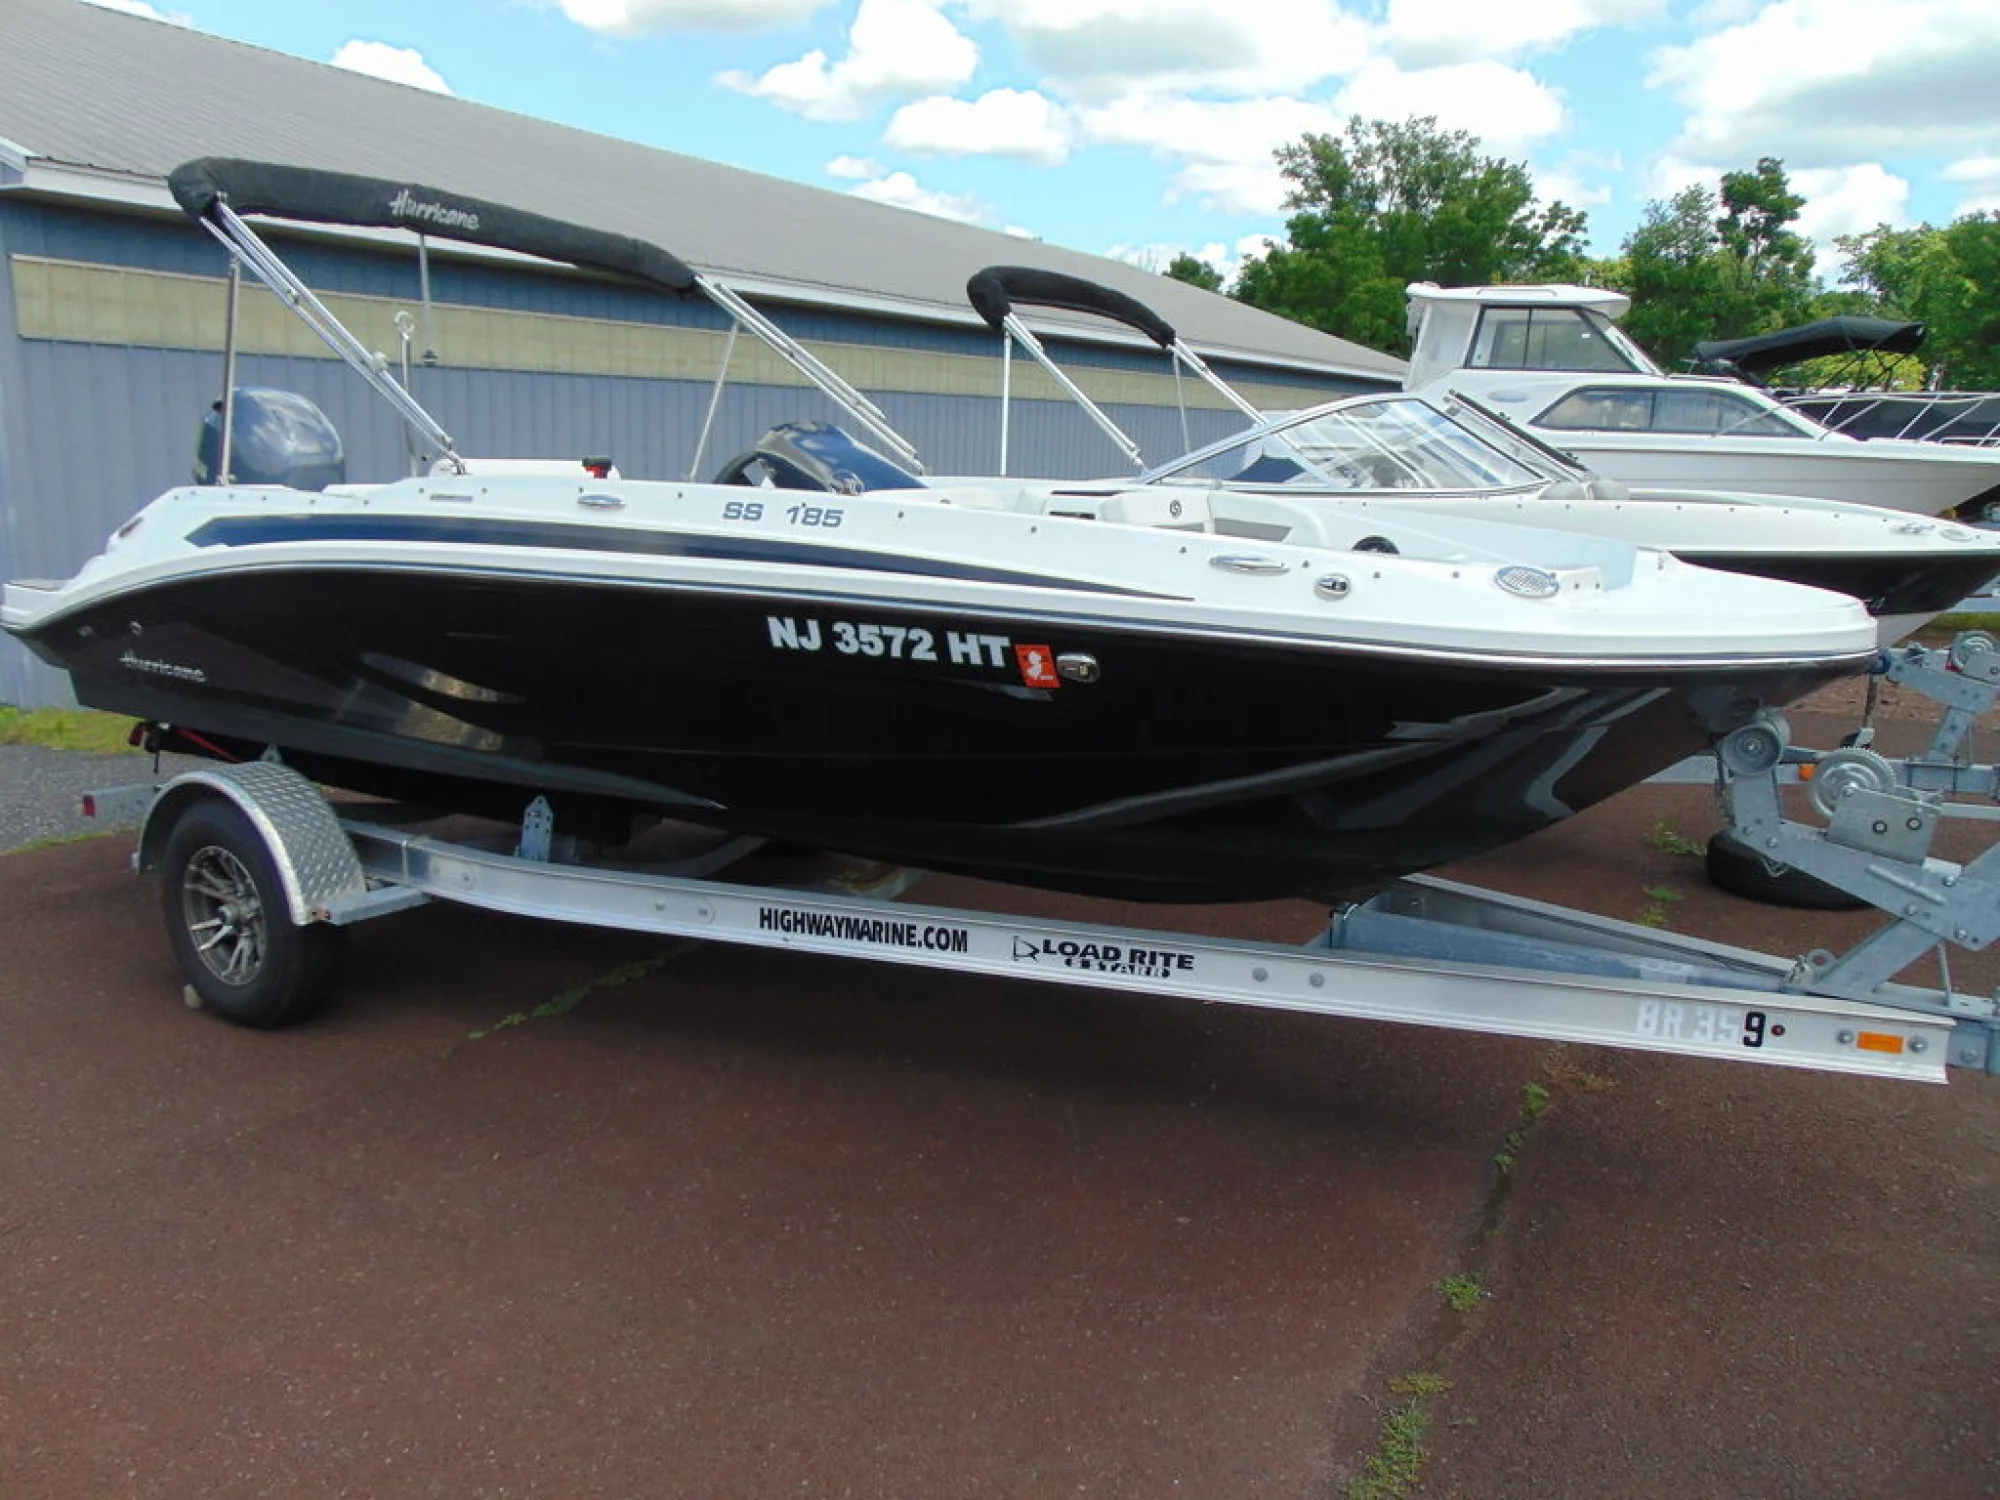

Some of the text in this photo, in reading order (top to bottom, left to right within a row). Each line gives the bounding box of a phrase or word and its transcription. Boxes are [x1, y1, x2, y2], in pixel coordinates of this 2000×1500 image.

[389, 188, 480, 230] Hurricane
[723, 501, 844, 528] SS 185
[767, 616, 1010, 667] NJ 3572 HT
[759, 907, 968, 953] HIGHWAYMARINE.COM
[1042, 939, 1122, 962] LOAD
[1128, 948, 1195, 970] RITE
